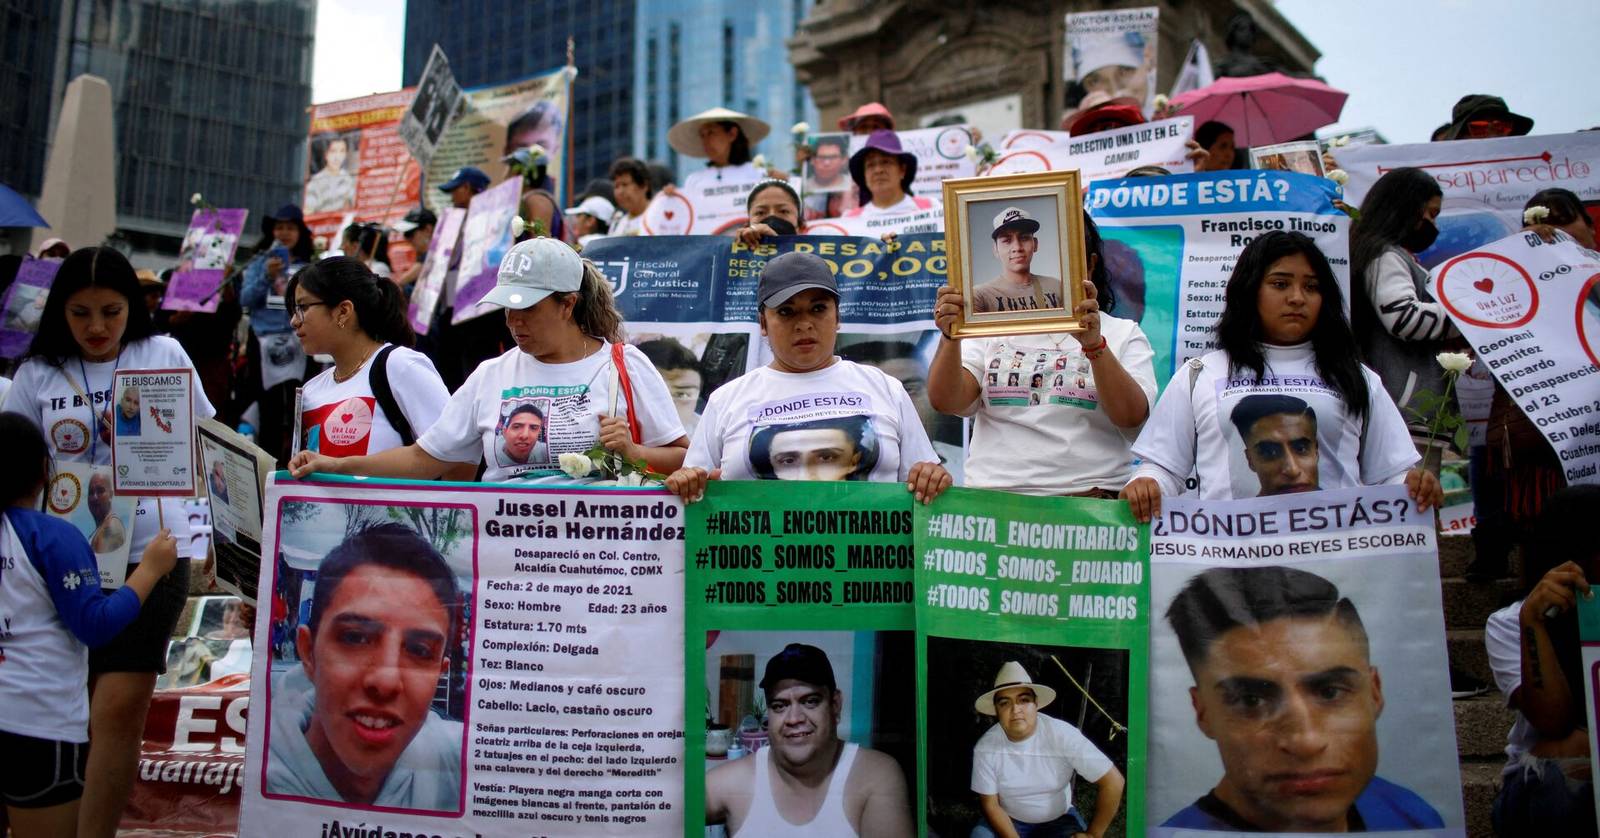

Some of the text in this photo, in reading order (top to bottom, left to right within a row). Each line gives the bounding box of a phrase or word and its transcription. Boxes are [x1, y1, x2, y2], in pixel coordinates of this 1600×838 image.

[1069, 124, 1179, 156] COLECTIVO UNA LUZ EN EL
[1104, 149, 1140, 165] CAMINO
[1197, 172, 1290, 205] ESTÁ?
[1201, 217, 1336, 233] Francisco Tinoco
[635, 260, 679, 270] Fiscalía
[633, 269, 680, 279] General
[632, 279, 699, 289] de Justicia
[1188, 280, 1219, 288] Fecha:
[1187, 294, 1213, 302] Sexo:
[1184, 340, 1203, 349] Tez:
[1477, 329, 1535, 355] Geovani
[1488, 345, 1543, 370] Benitez
[1499, 359, 1556, 384] Ricardo
[121, 375, 182, 387] TE BUSCAMOS
[50, 396, 67, 411] TE
[814, 395, 862, 406] ESTÁS?
[1524, 393, 1561, 413] el 23
[1536, 404, 1592, 427] Octubre
[1547, 431, 1569, 443] En
[1566, 463, 1597, 481] Ciudad
[495, 499, 678, 519] Jussel Armando
[1154, 496, 1409, 537] ¿DÓNDE ESTÁS?
[485, 519, 685, 541] García Hernández
[706, 510, 912, 537] #HASTA_ENCONTRARLOS
[927, 513, 1139, 552] #HASTA_ENCONTRARLOS
[514, 548, 661, 562] Desapareció en Col. Centro,
[1150, 533, 1427, 560] JESUS ARMANDO REYES ESCOBAR
[696, 543, 914, 572] #TODOS_SOMOS_MARCOS
[514, 563, 663, 576] Alcaldía Cuahutémoc, CDMX
[487, 580, 633, 597] Fecha: 2 de mayo de 2021
[705, 581, 914, 607] #TODOS_SOMOS_EDUARDO
[484, 600, 668, 614] Sexo: Hombre Edad: 23 años
[927, 584, 1137, 620] #TODOS_SOMOS_MARCOS
[484, 619, 587, 634] Estatura: 1.70 mts
[482, 639, 599, 656] Complexión: Delgada
[480, 658, 544, 671] Tez: Blanco
[479, 678, 646, 696] Ojos: Medianos y café oscuro
[478, 699, 653, 716] Cabello: Lacio, castaño oscuro
[476, 723, 505, 734] Señas
[508, 725, 569, 738] particulares:
[571, 728, 639, 739] Perforaciones
[642, 731, 654, 739] en
[475, 737, 645, 754] cicatriz arriba de la ceja izquierda,
[474, 749, 677, 766] 2 tatuajes en el pecho: del lado izquierdo
[474, 764, 492, 772] una
[495, 765, 535, 774] calavera
[537, 768, 544, 776] y
[546, 767, 561, 776] del
[563, 767, 604, 777] derecho
[474, 782, 506, 793] Vestía:
[508, 784, 544, 796] Playera
[547, 788, 575, 798] negra
[578, 789, 612, 799] manga
[615, 789, 642, 798] corta
[473, 796, 672, 812] imágenes blancas al frente, pantalón de
[473, 809, 646, 824] mezclilla azul oscuro y tenis negros
